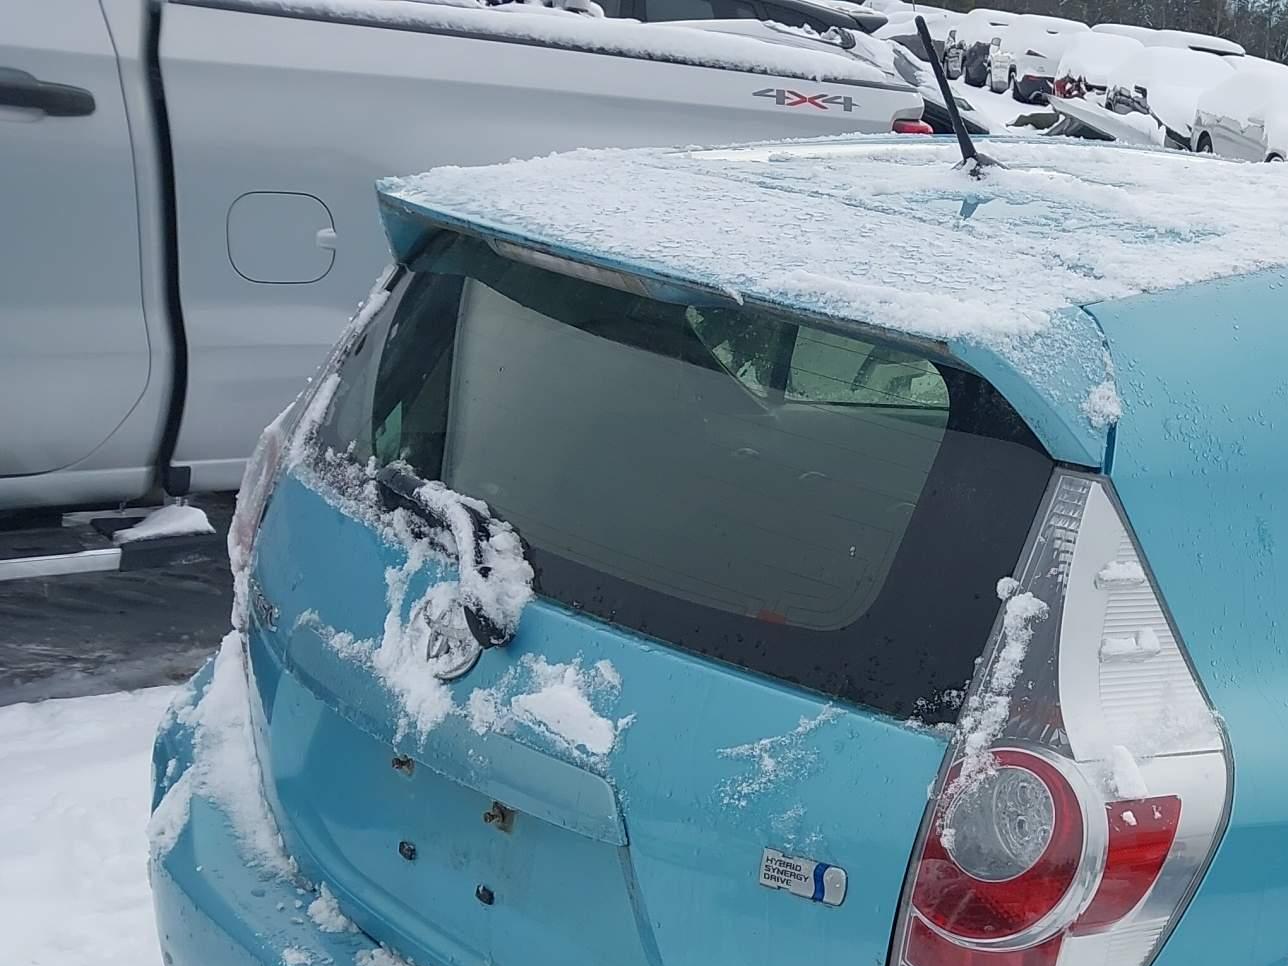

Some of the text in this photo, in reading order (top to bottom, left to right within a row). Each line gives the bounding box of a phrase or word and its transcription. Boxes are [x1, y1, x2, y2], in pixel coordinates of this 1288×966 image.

[766, 855, 802, 872] HYBRID
[763, 872, 792, 887] DRIVE
[764, 864, 809, 883] SYNERGY
